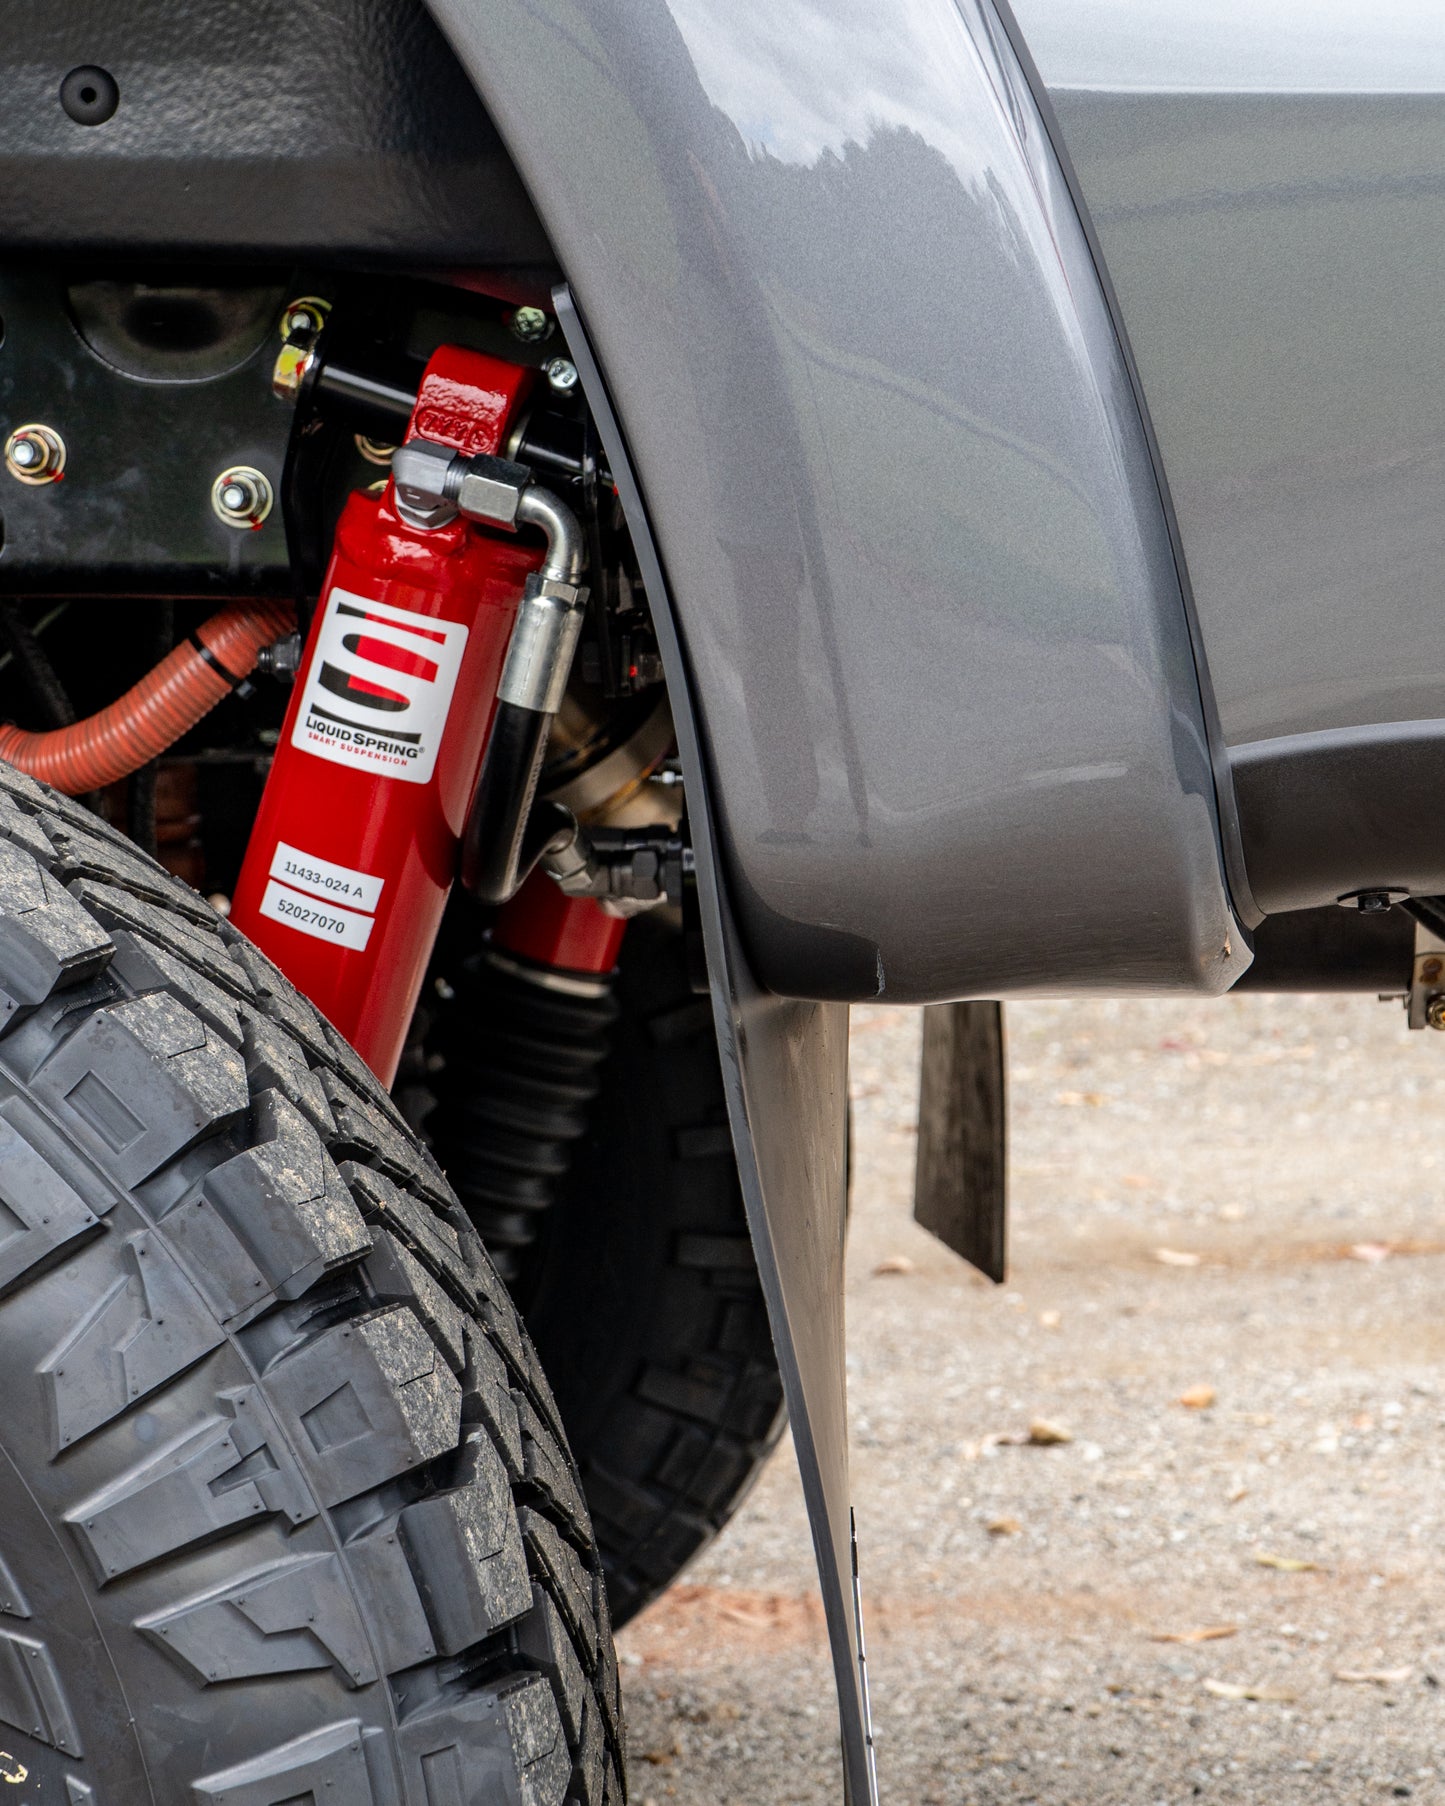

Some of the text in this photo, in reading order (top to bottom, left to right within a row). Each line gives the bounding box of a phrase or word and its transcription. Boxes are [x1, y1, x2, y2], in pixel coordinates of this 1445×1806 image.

[308, 731, 408, 766] SMART SUSPENSION
[284, 861, 363, 898] 11433-024 A
[277, 899, 345, 934] 52027070
